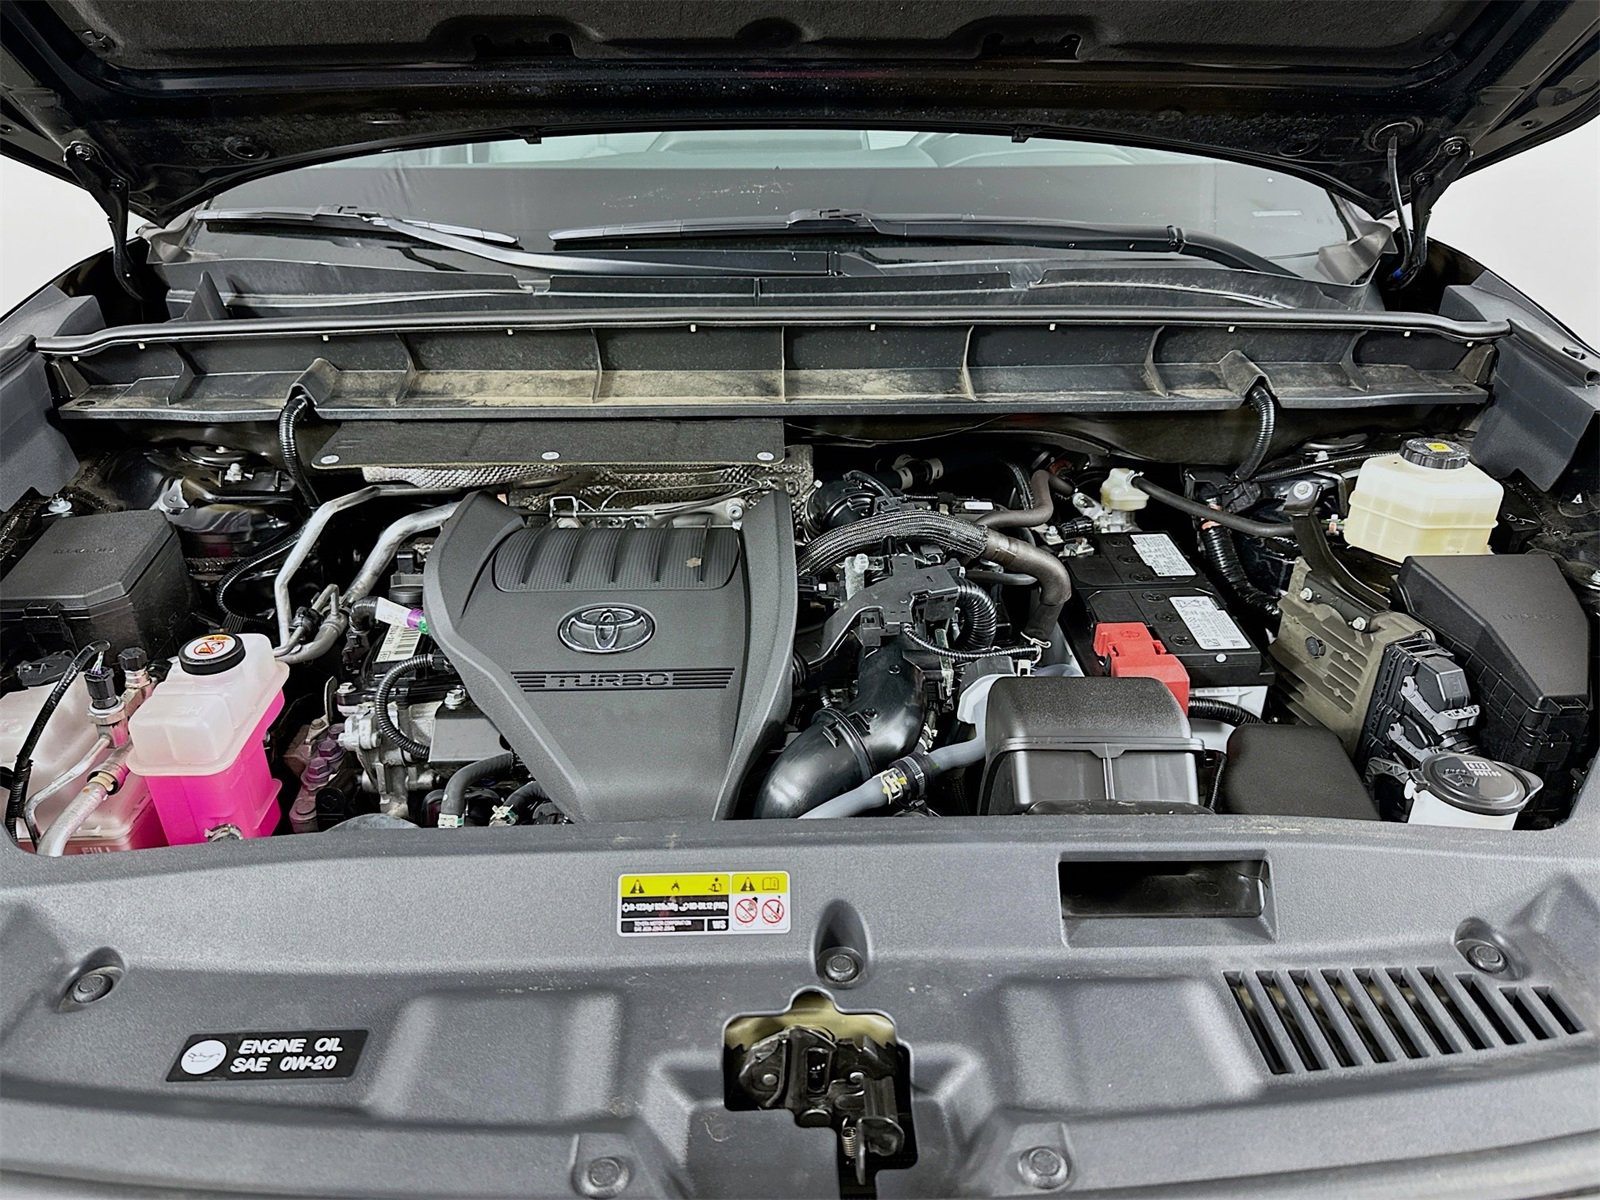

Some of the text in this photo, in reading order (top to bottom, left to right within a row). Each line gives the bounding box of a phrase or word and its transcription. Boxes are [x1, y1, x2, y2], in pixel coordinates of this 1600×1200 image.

[550, 671, 669, 688] TURBO
[238, 1037, 343, 1054] ENGINE OIL
[230, 1055, 337, 1073] SAE 0W-20
